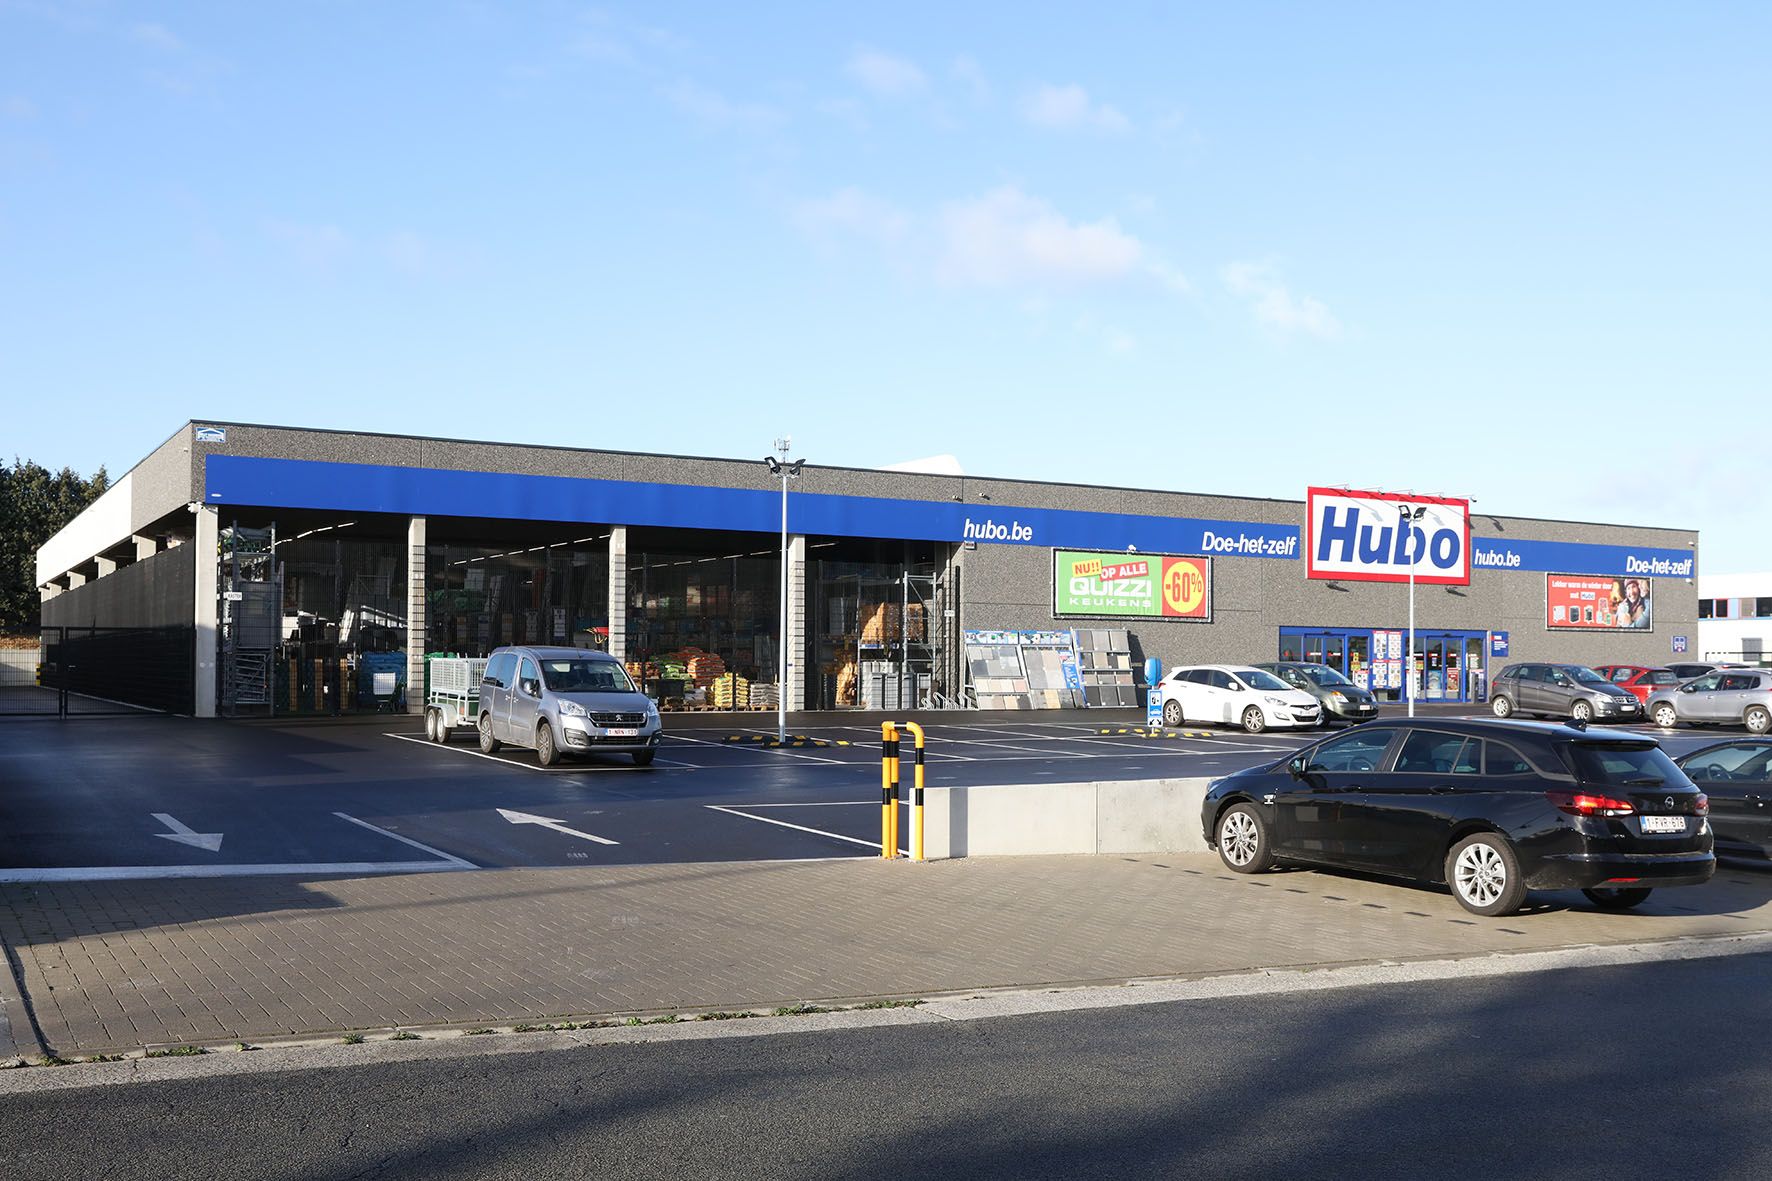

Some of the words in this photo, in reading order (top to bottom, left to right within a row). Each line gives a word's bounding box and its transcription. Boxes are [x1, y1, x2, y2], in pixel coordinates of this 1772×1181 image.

[963, 518, 1033, 542] hubo.be
[1317, 505, 1460, 569] Hubo
[1201, 530, 1297, 556] Doe-het-zelf
[1474, 548, 1521, 567] hubo.be
[1626, 555, 1693, 576] Doe-het-zelf
[1074, 561, 1100, 575] NU!!
[1101, 567, 1113, 579] OP
[1119, 563, 1147, 576] ALLE
[1069, 577, 1152, 597] QUIZZI
[1165, 571, 1203, 603] -60%
[1069, 597, 1152, 608] KEUKENS
